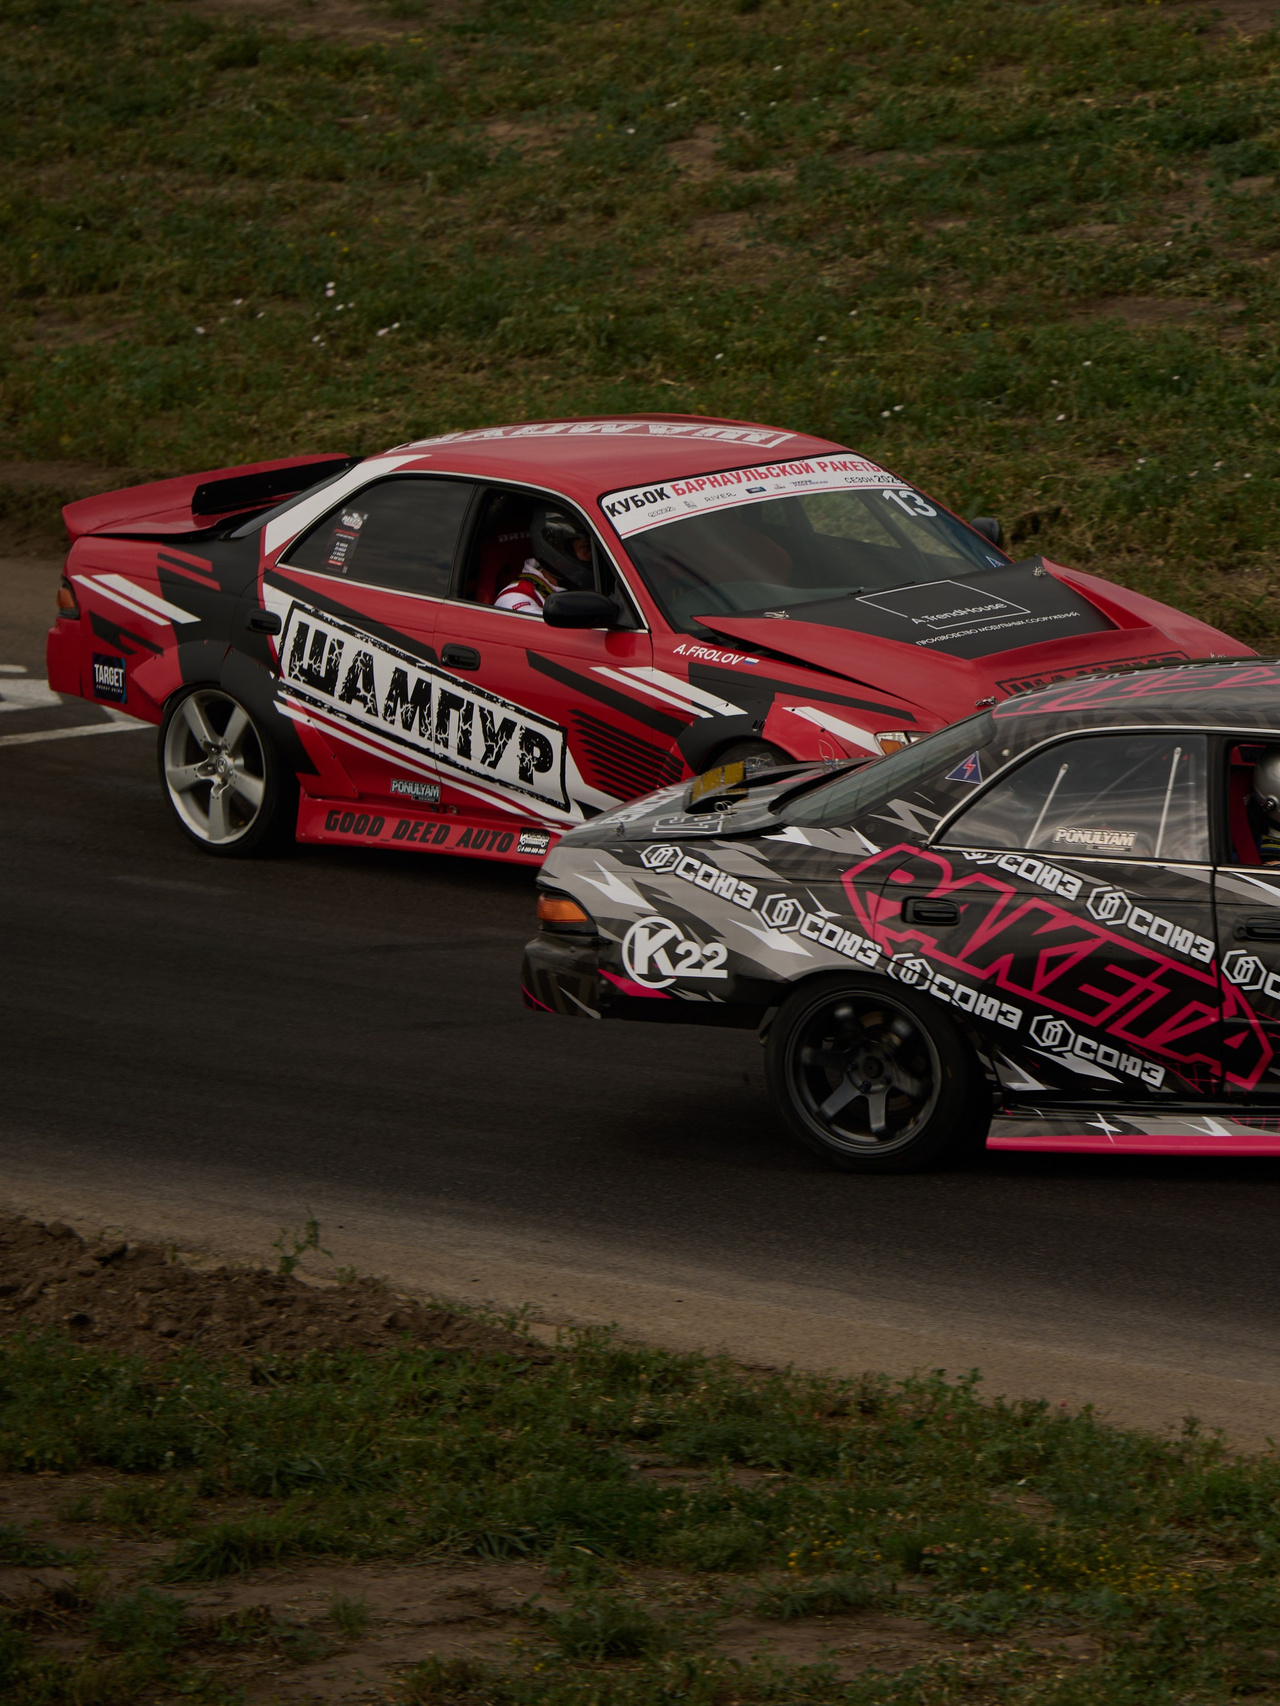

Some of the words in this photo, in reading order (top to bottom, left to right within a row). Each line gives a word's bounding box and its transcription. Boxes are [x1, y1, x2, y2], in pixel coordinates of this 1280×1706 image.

[605, 487, 670, 518] КУБОК
[670, 460, 815, 497] БАРНАУЛЬСКОЙ
[882, 489, 937, 517] 13
[498, 531, 531, 543] BRI
[911, 602, 1007, 626] A.TrendHouse
[94, 664, 124, 688] TARGET
[673, 644, 745, 665] A.FROLOV
[288, 620, 553, 785] ШАМПУР
[391, 779, 440, 798] PONULYAM
[1053, 828, 1137, 847] PONULYAM
[675, 855, 758, 910] СОЮЗ
[999, 852, 1084, 901] СОЮЗ
[801, 912, 883, 969] СОЮЗ
[1127, 910, 1216, 964] СОЮЗ
[929, 973, 1023, 1030] СОЮЗ
[1072, 1037, 1166, 1087] СОЮЗ
